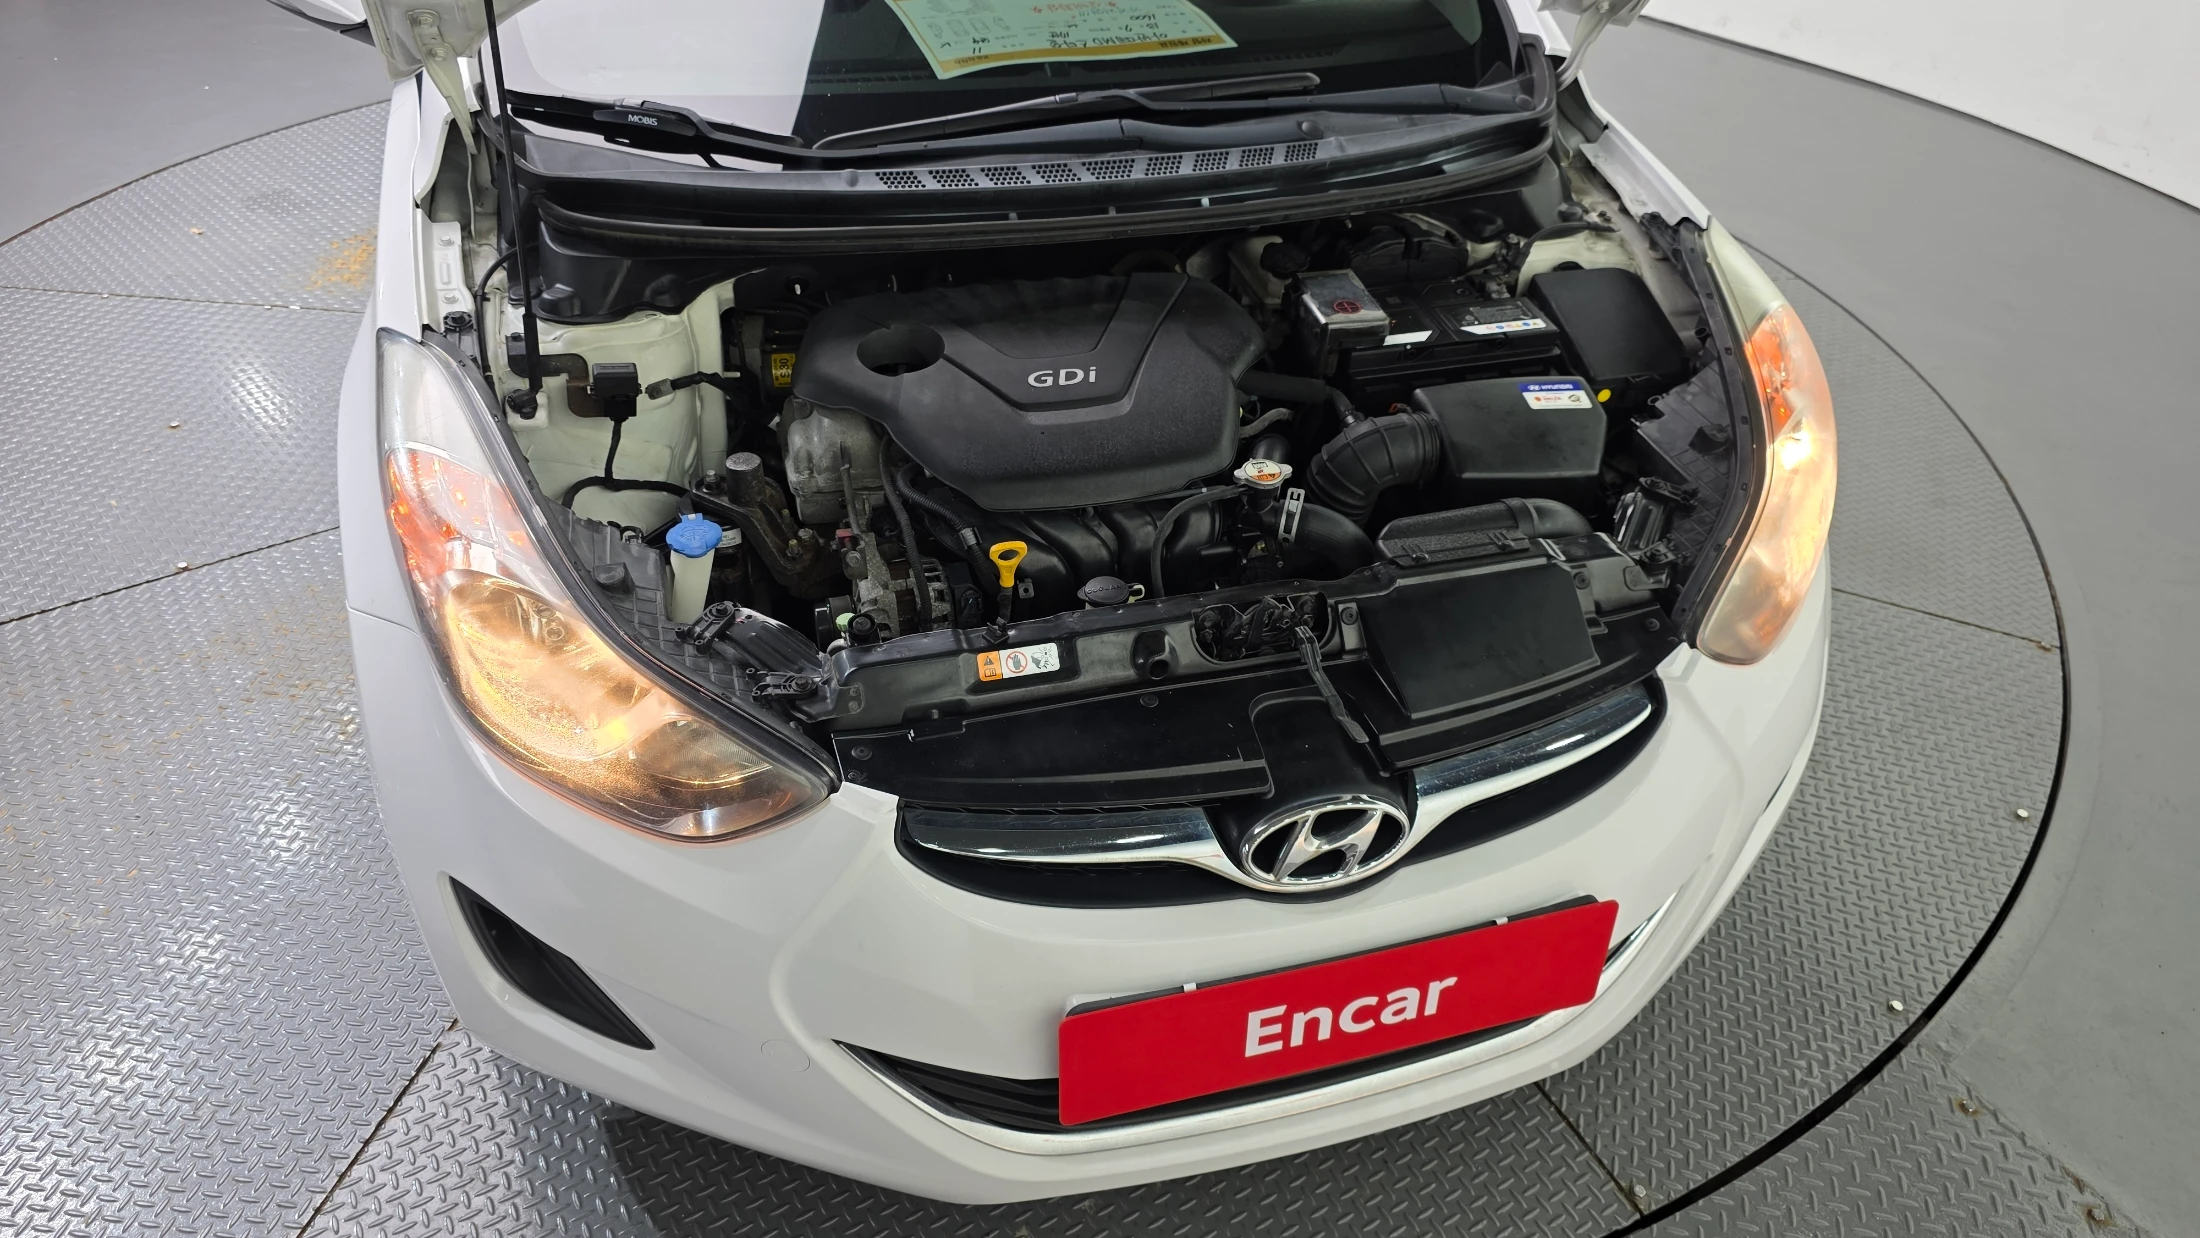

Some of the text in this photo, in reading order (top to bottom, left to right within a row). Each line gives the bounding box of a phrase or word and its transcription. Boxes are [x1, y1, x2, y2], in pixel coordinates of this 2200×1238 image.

[628, 114, 658, 125] MOBIS
[1027, 366, 1097, 388] GDi
[1244, 976, 1458, 1057] Encar
